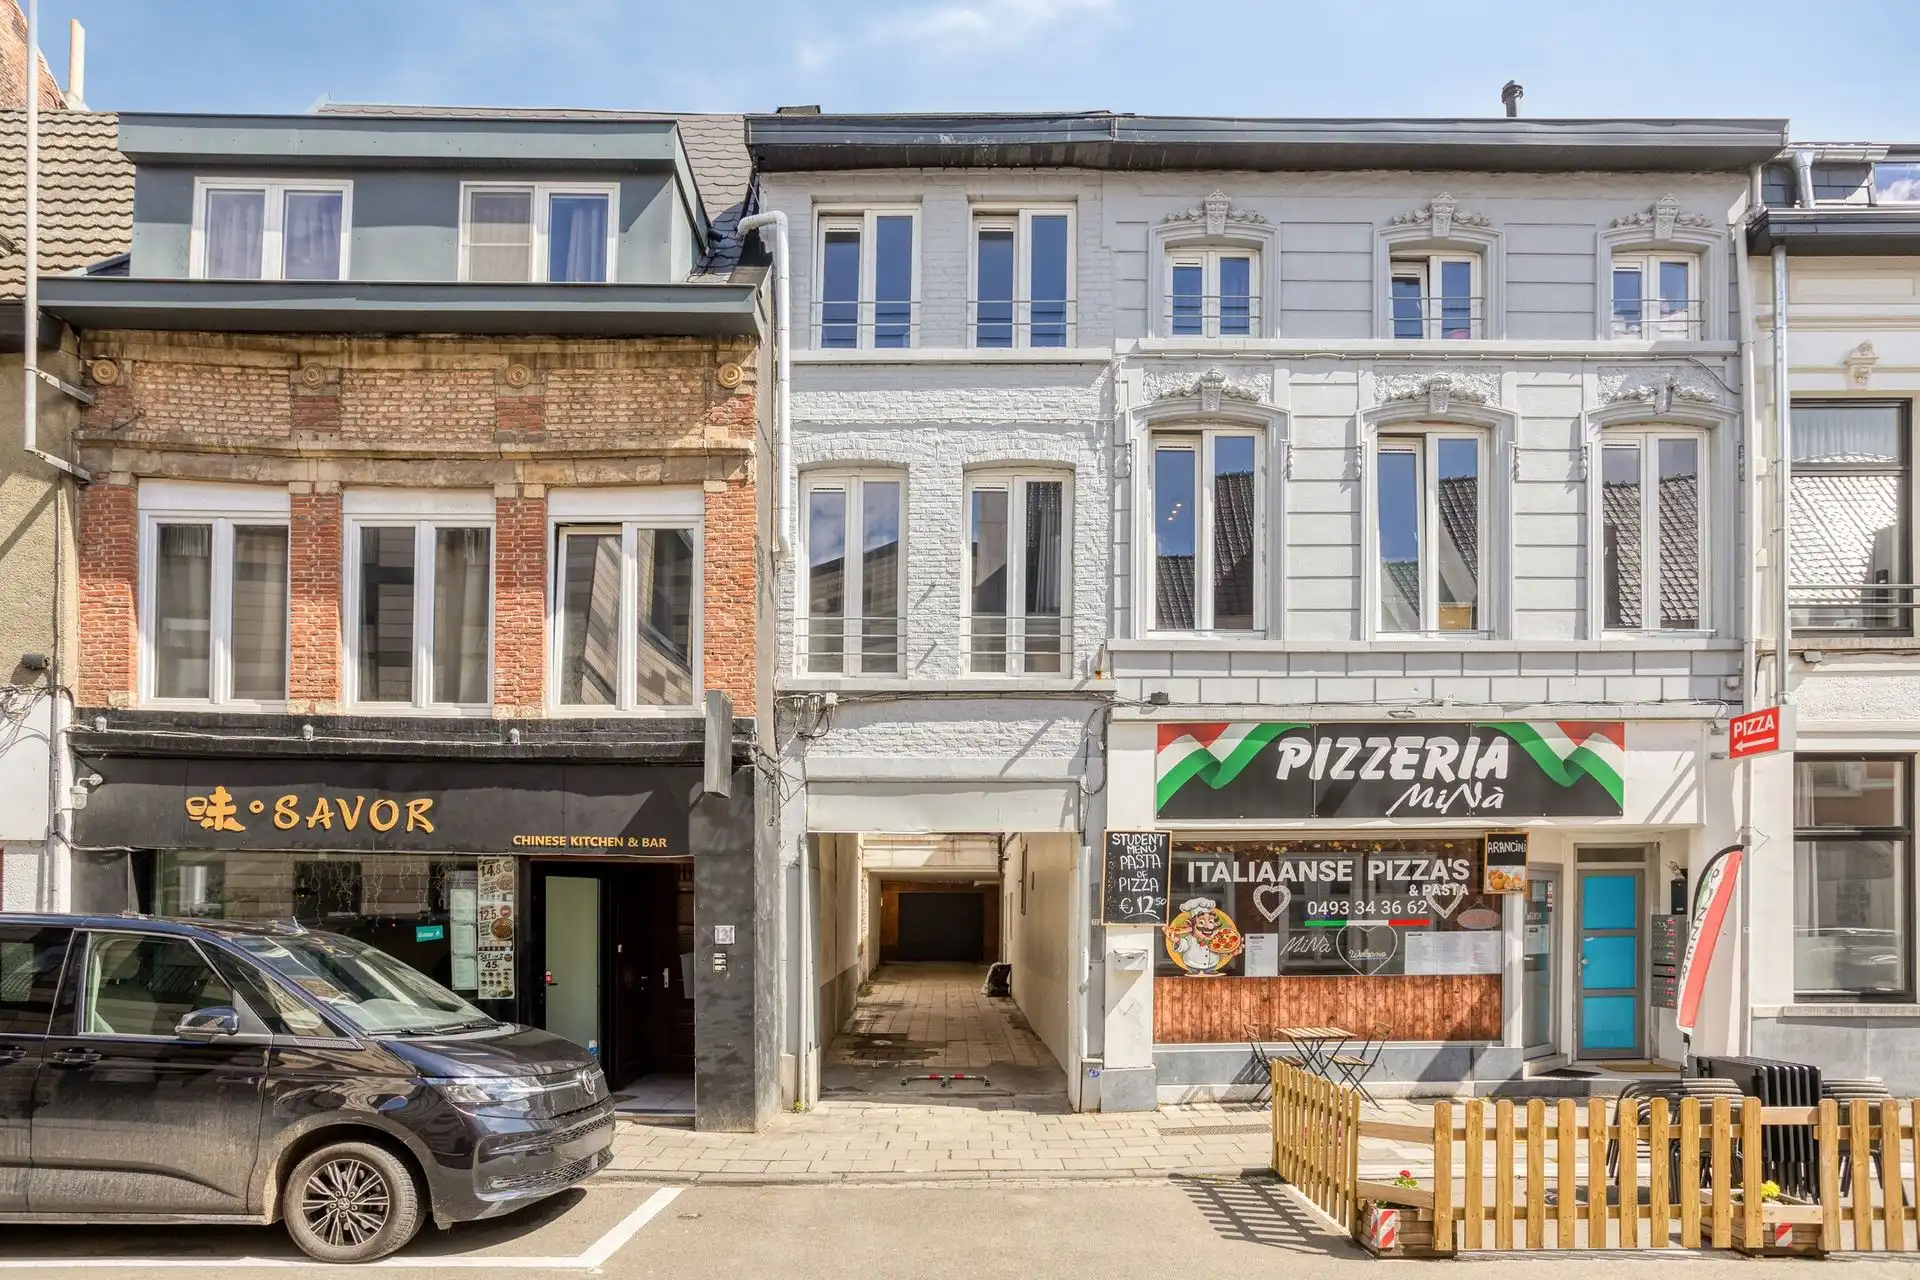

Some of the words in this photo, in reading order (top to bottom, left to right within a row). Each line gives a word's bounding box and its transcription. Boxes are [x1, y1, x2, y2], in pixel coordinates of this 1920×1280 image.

[1734, 714, 1775, 738] PIZZA
[1276, 736, 1509, 783] PIZZERIA
[185, 785, 246, 832] 味
[273, 794, 434, 833] SAVOR
[513, 835, 566, 847] CHINESE
[570, 836, 624, 848] KITCHEN
[628, 837, 639, 848] &
[642, 837, 668, 848] BAR
[1112, 833, 1167, 847] STUDENT
[1127, 845, 1157, 855] MENU
[1120, 854, 1161, 870] PASTA
[1136, 870, 1148, 879] OF
[1187, 860, 1353, 883] ITALIAANSE
[1367, 858, 1470, 881] PIZZA'S
[1118, 877, 1159, 892] PIZZA
[1408, 883, 1419, 896] &
[1422, 883, 1469, 896] PASTA
[1307, 900, 1350, 915] 0493
[1354, 900, 1376, 915] 34
[1381, 900, 1402, 915] 36
[1406, 900, 1428, 915] 62
